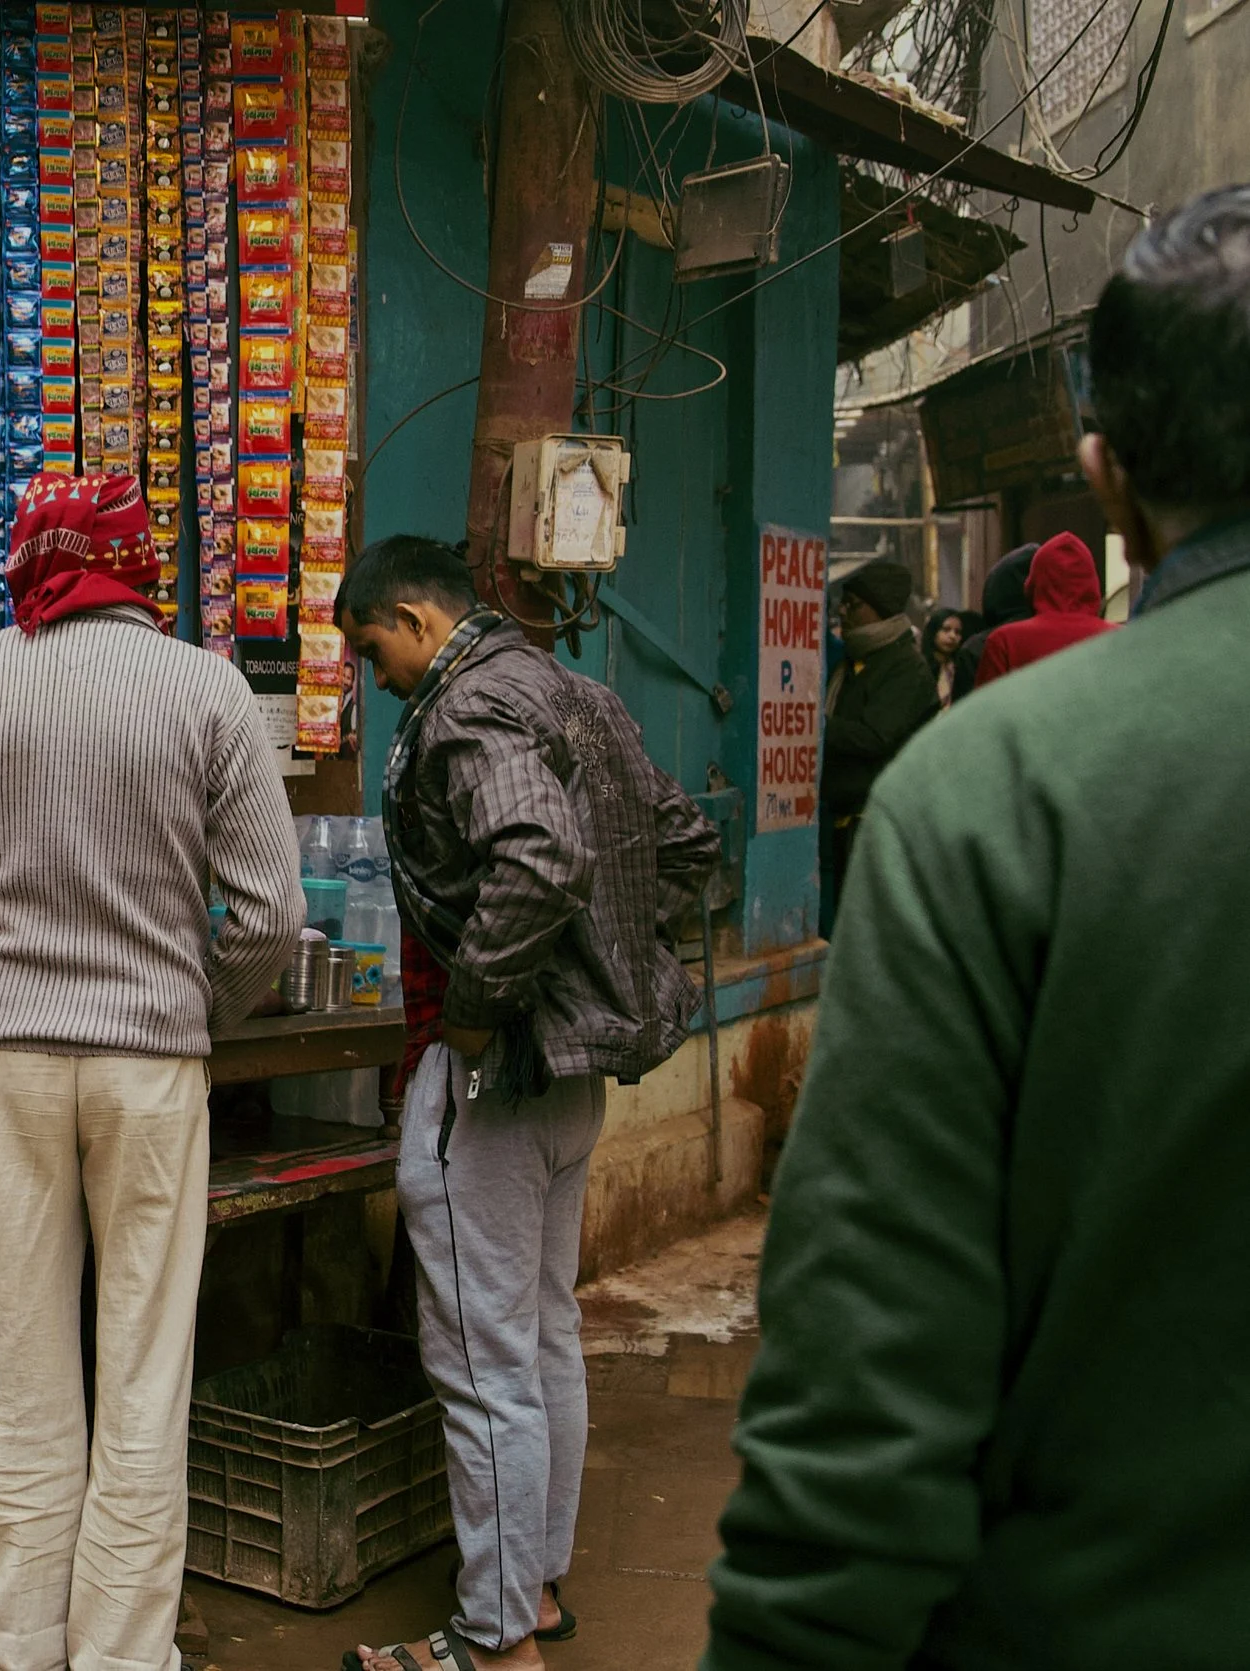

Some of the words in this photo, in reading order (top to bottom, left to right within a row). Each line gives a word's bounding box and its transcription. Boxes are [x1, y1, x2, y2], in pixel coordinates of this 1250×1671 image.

[762, 534, 825, 591] PEACE
[764, 598, 820, 650] HOME
[245, 660, 276, 674] TOBACCO
[761, 702, 816, 737] GUEST
[762, 745, 817, 785] HOUSE
